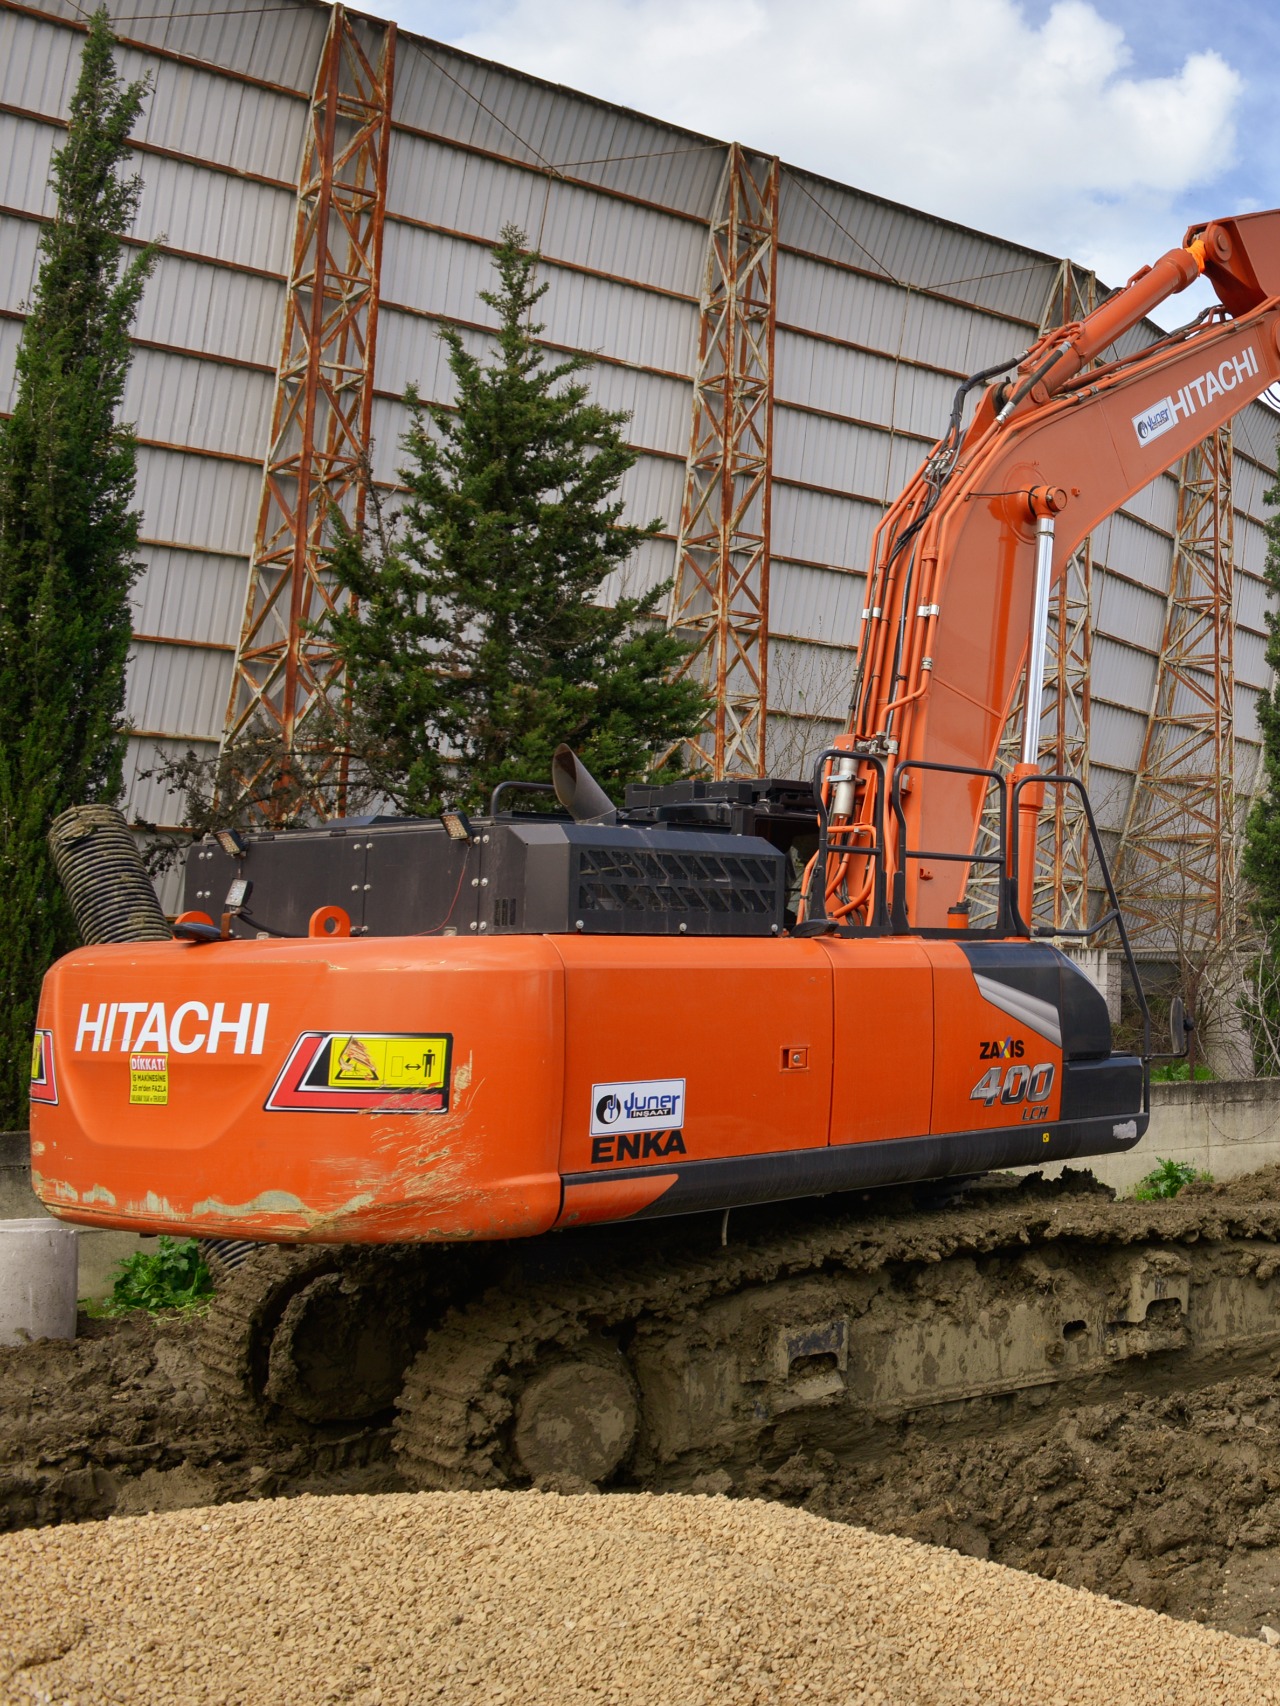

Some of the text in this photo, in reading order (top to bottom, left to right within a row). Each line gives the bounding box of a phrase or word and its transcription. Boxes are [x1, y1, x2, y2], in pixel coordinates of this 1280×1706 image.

[1166, 346, 1259, 425] HITACHI
[74, 1001, 270, 1055] HITACHI
[979, 1035, 1025, 1060] ZAXIS
[131, 1056, 166, 1070] DİKKAT!
[132, 1084, 138, 1092] 25
[969, 1062, 1055, 1107] 400
[624, 1091, 681, 1119] Yuner
[632, 1108, 670, 1118] İNŞAAT
[1022, 1105, 1049, 1121] LCH
[591, 1130, 687, 1164] ENKA
